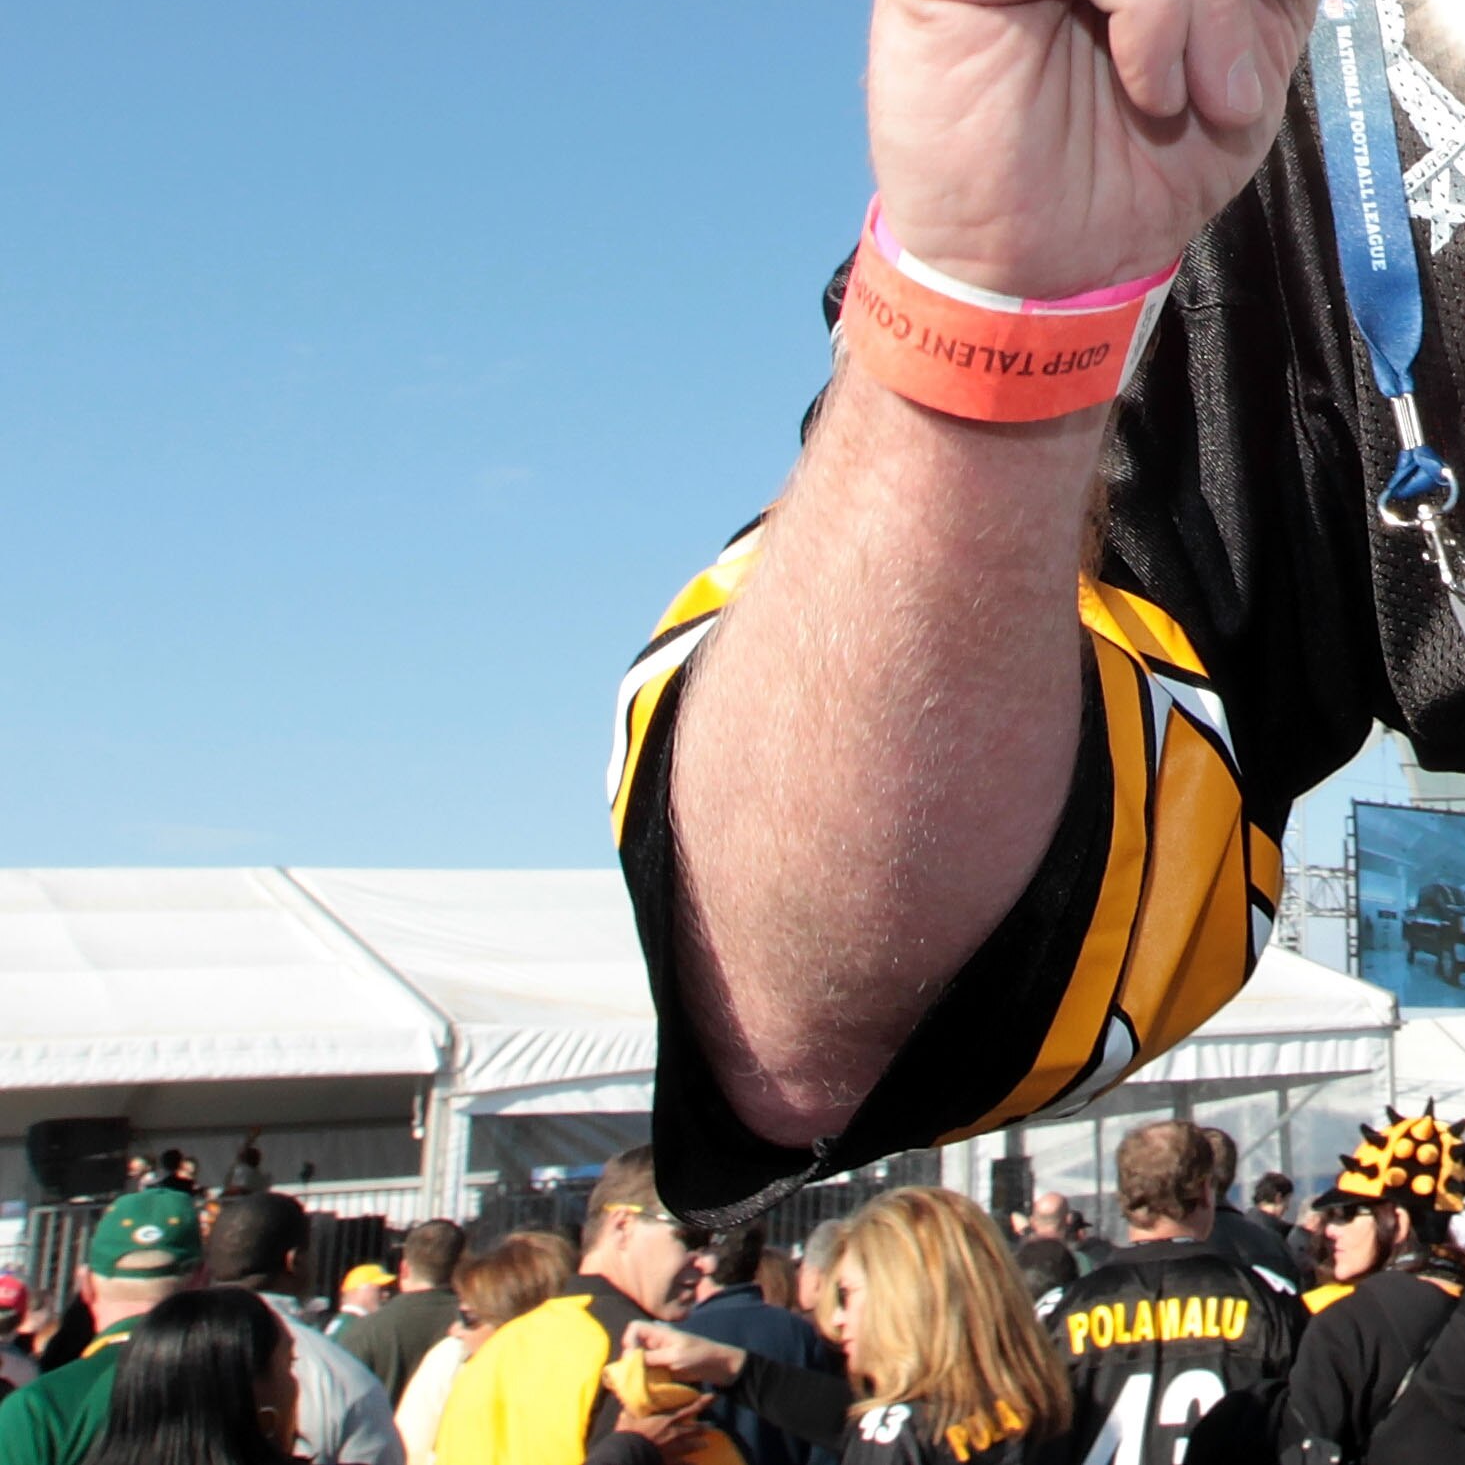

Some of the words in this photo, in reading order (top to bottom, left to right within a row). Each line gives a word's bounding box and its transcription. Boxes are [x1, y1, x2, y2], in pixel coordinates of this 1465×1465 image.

[1336, 24, 1363, 108] NATIONAL
[1349, 110, 1375, 200] FOOTBALL
[1362, 200, 1388, 272] LEAGUE
[916, 326, 1035, 377] TALENT
[1041, 342, 1110, 376] GDFP
[1066, 1295, 1249, 1355] POLAMALU
[858, 1403, 912, 1444] 43
